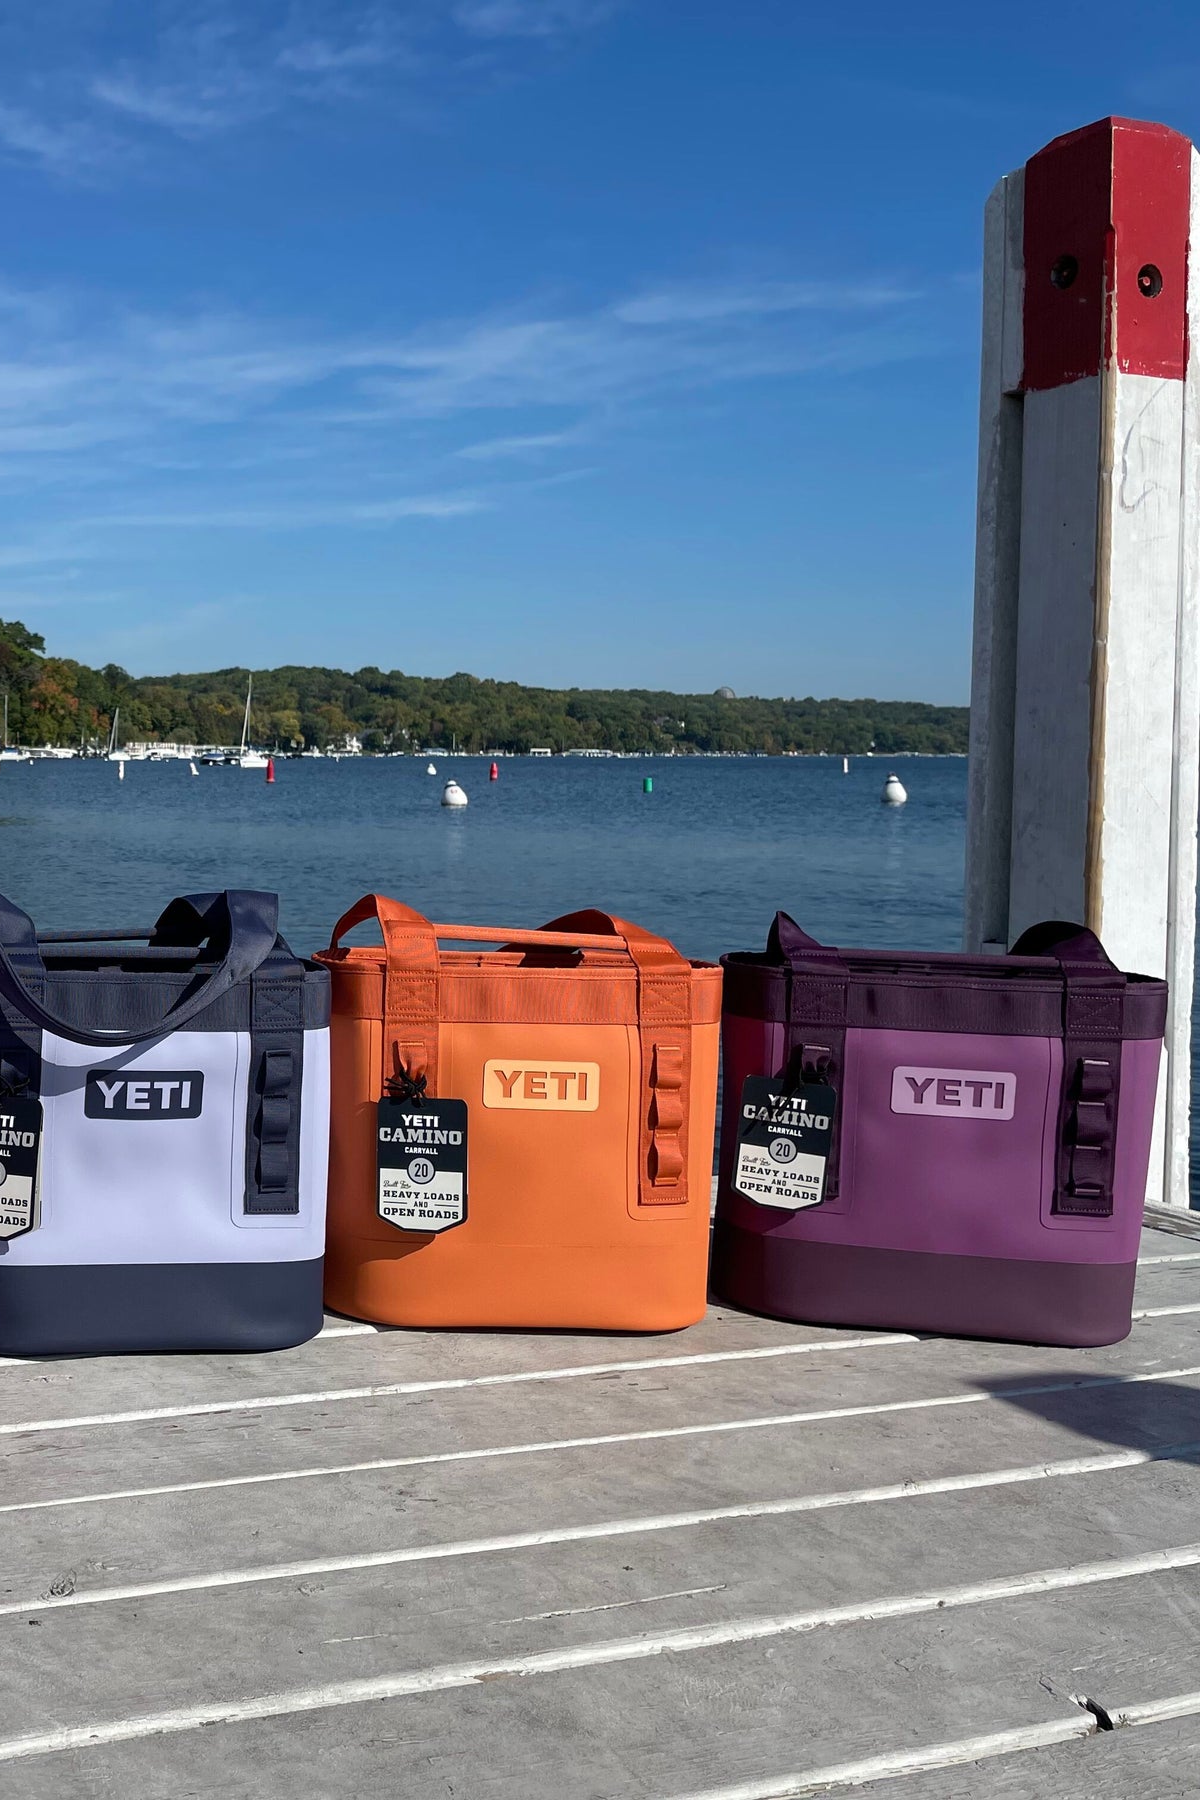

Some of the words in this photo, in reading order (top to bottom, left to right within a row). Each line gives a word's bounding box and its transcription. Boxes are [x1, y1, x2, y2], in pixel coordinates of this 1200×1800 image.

[494, 1069, 588, 1101] YETI
[904, 1076, 1005, 1109] YETI
[95, 1080, 192, 1110] YETI
[401, 1114, 439, 1128] YETI
[743, 1104, 829, 1130] CAMINO
[379, 1127, 462, 1145] CAMINO
[767, 1125, 803, 1137] CARRYALL
[404, 1147, 438, 1155] CARRYALL
[775, 1143, 790, 1157] 20
[414, 1163, 428, 1177] 20
[741, 1164, 780, 1177] HEAVY
[783, 1171, 820, 1184] LOADS
[383, 1190, 420, 1199] HEAVY
[423, 1192, 460, 1201] LOADS
[740, 1181, 773, 1193] OPEN
[775, 1187, 818, 1201] ROADS
[383, 1207, 415, 1217] OPEN
[418, 1209, 459, 1220] ROADS
